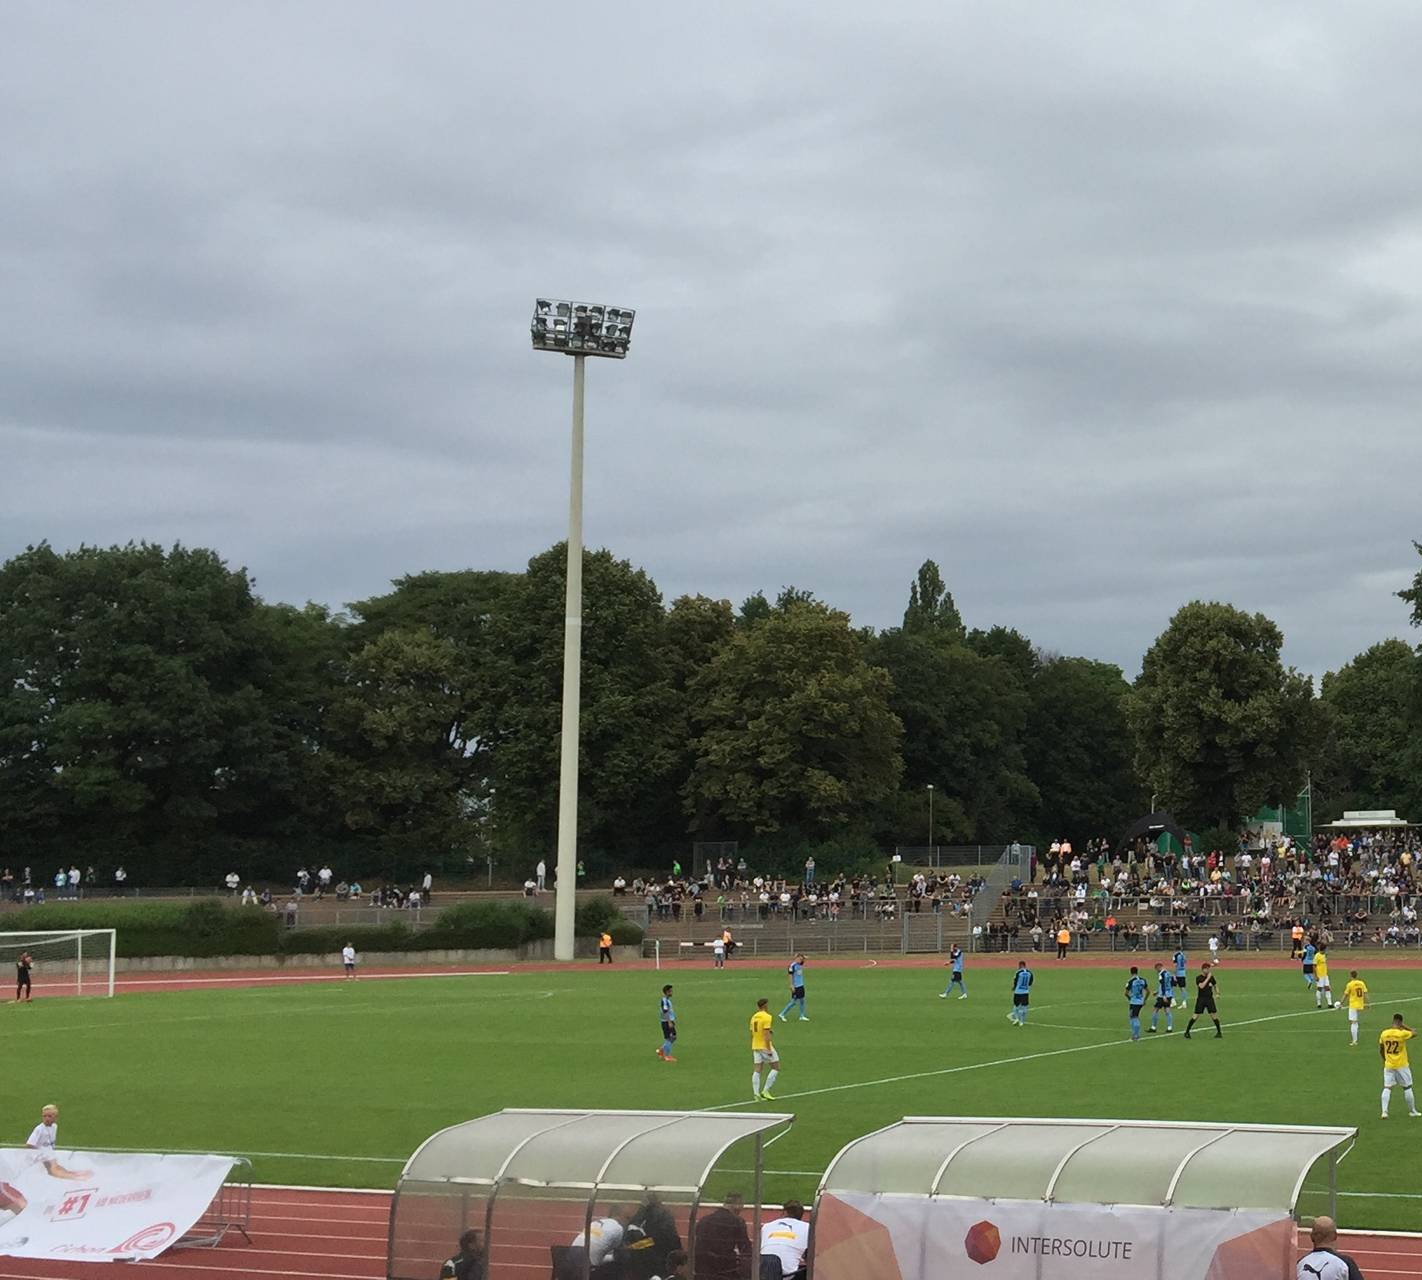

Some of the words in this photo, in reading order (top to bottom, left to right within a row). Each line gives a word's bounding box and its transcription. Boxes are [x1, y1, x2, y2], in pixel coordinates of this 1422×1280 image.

[1385, 1040, 1400, 1055] 22
[58, 1193, 92, 1215] #1
[1011, 1236, 1133, 1260] INTERSOLUTE
